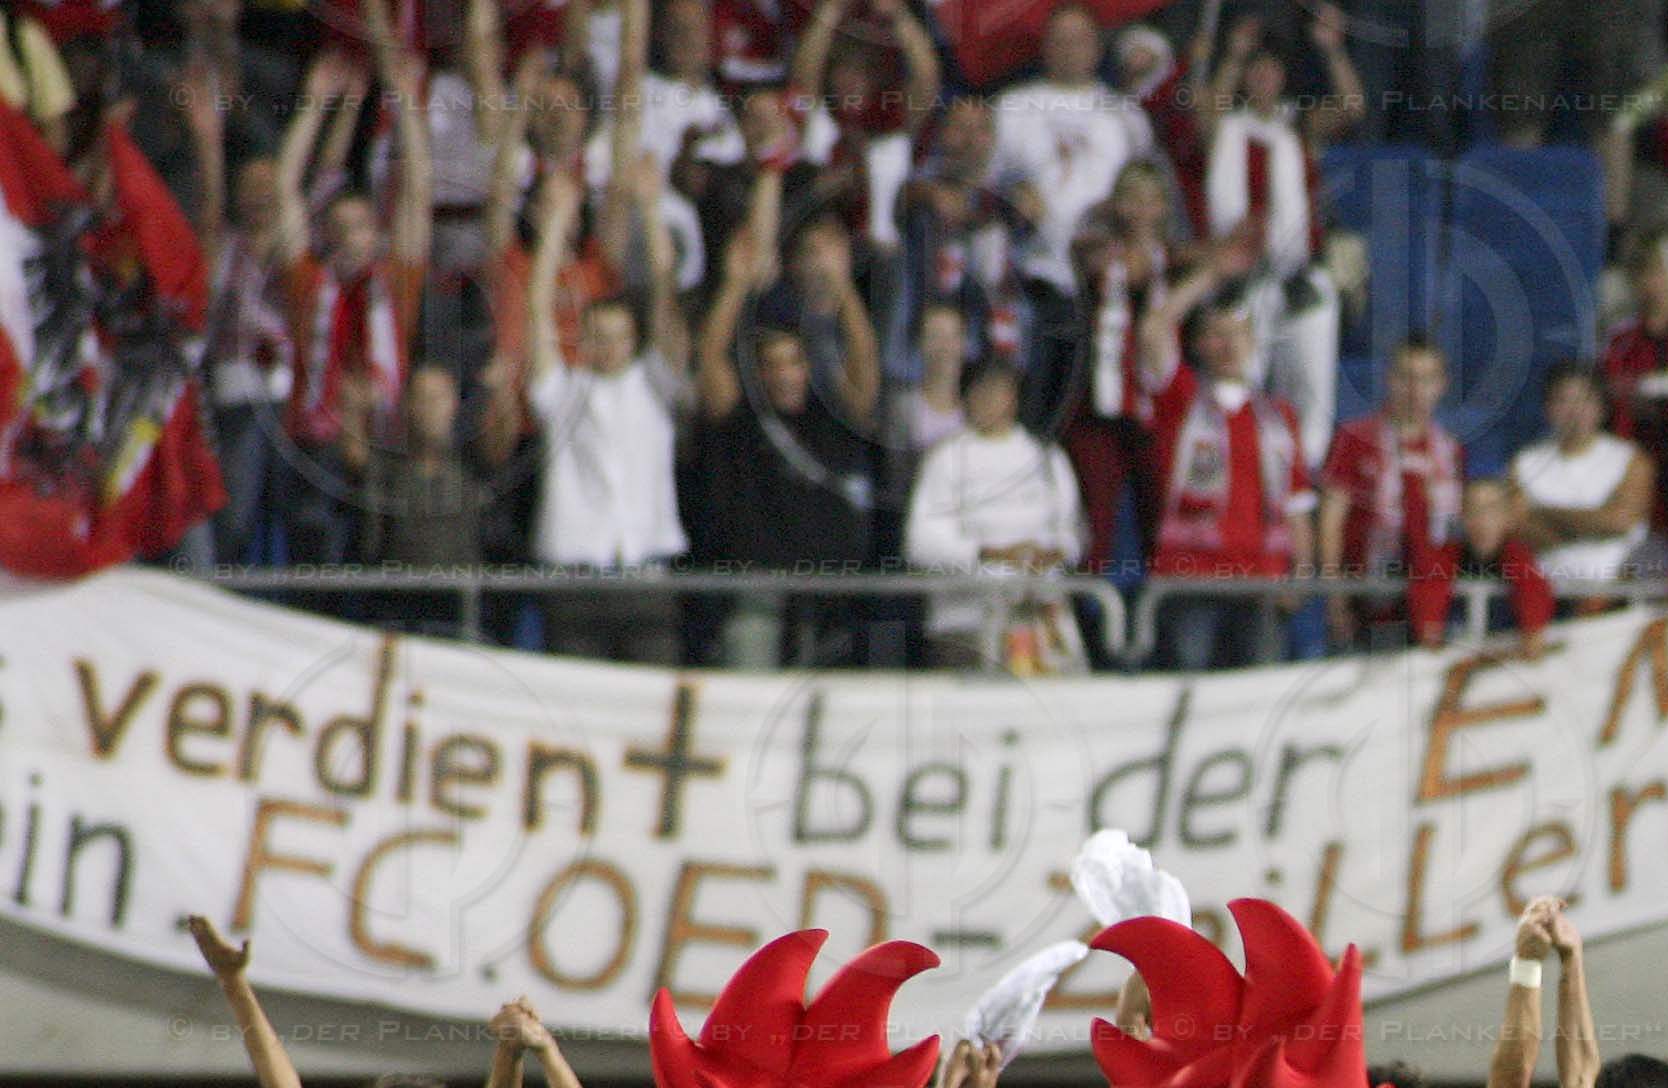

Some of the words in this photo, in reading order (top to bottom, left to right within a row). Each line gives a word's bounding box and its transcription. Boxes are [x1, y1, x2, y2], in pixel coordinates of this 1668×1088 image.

[73, 632, 729, 843] verdient
[793, 688, 1018, 850] bei
[1083, 682, 1347, 850] der
[0, 770, 134, 930] in
